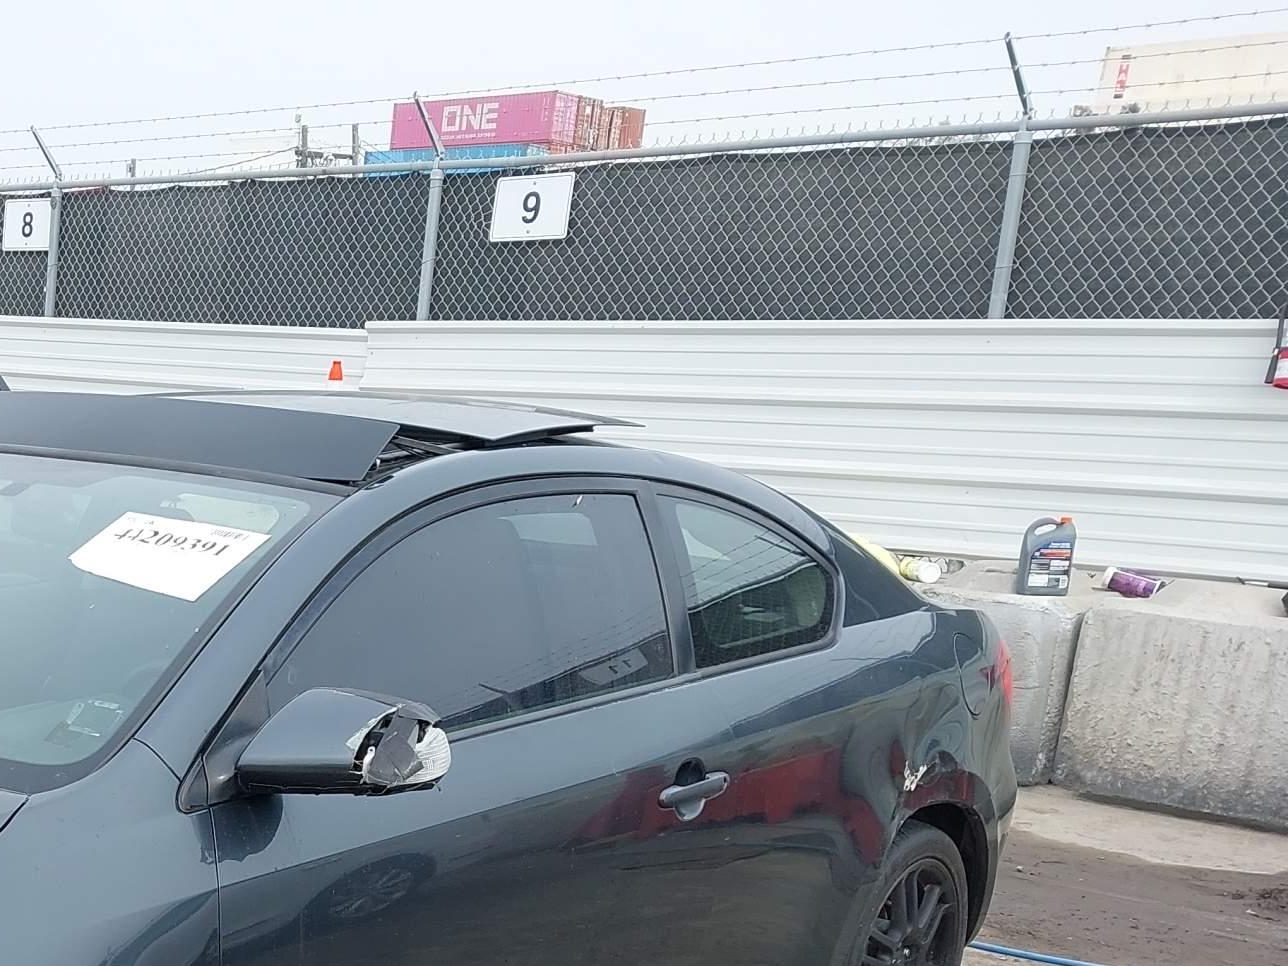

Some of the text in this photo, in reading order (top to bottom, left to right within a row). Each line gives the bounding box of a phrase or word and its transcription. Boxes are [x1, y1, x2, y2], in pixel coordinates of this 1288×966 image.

[441, 102, 499, 132] ONE
[522, 191, 541, 224] 9
[22, 212, 33, 238] 8
[114, 529, 230, 556] 44209391
